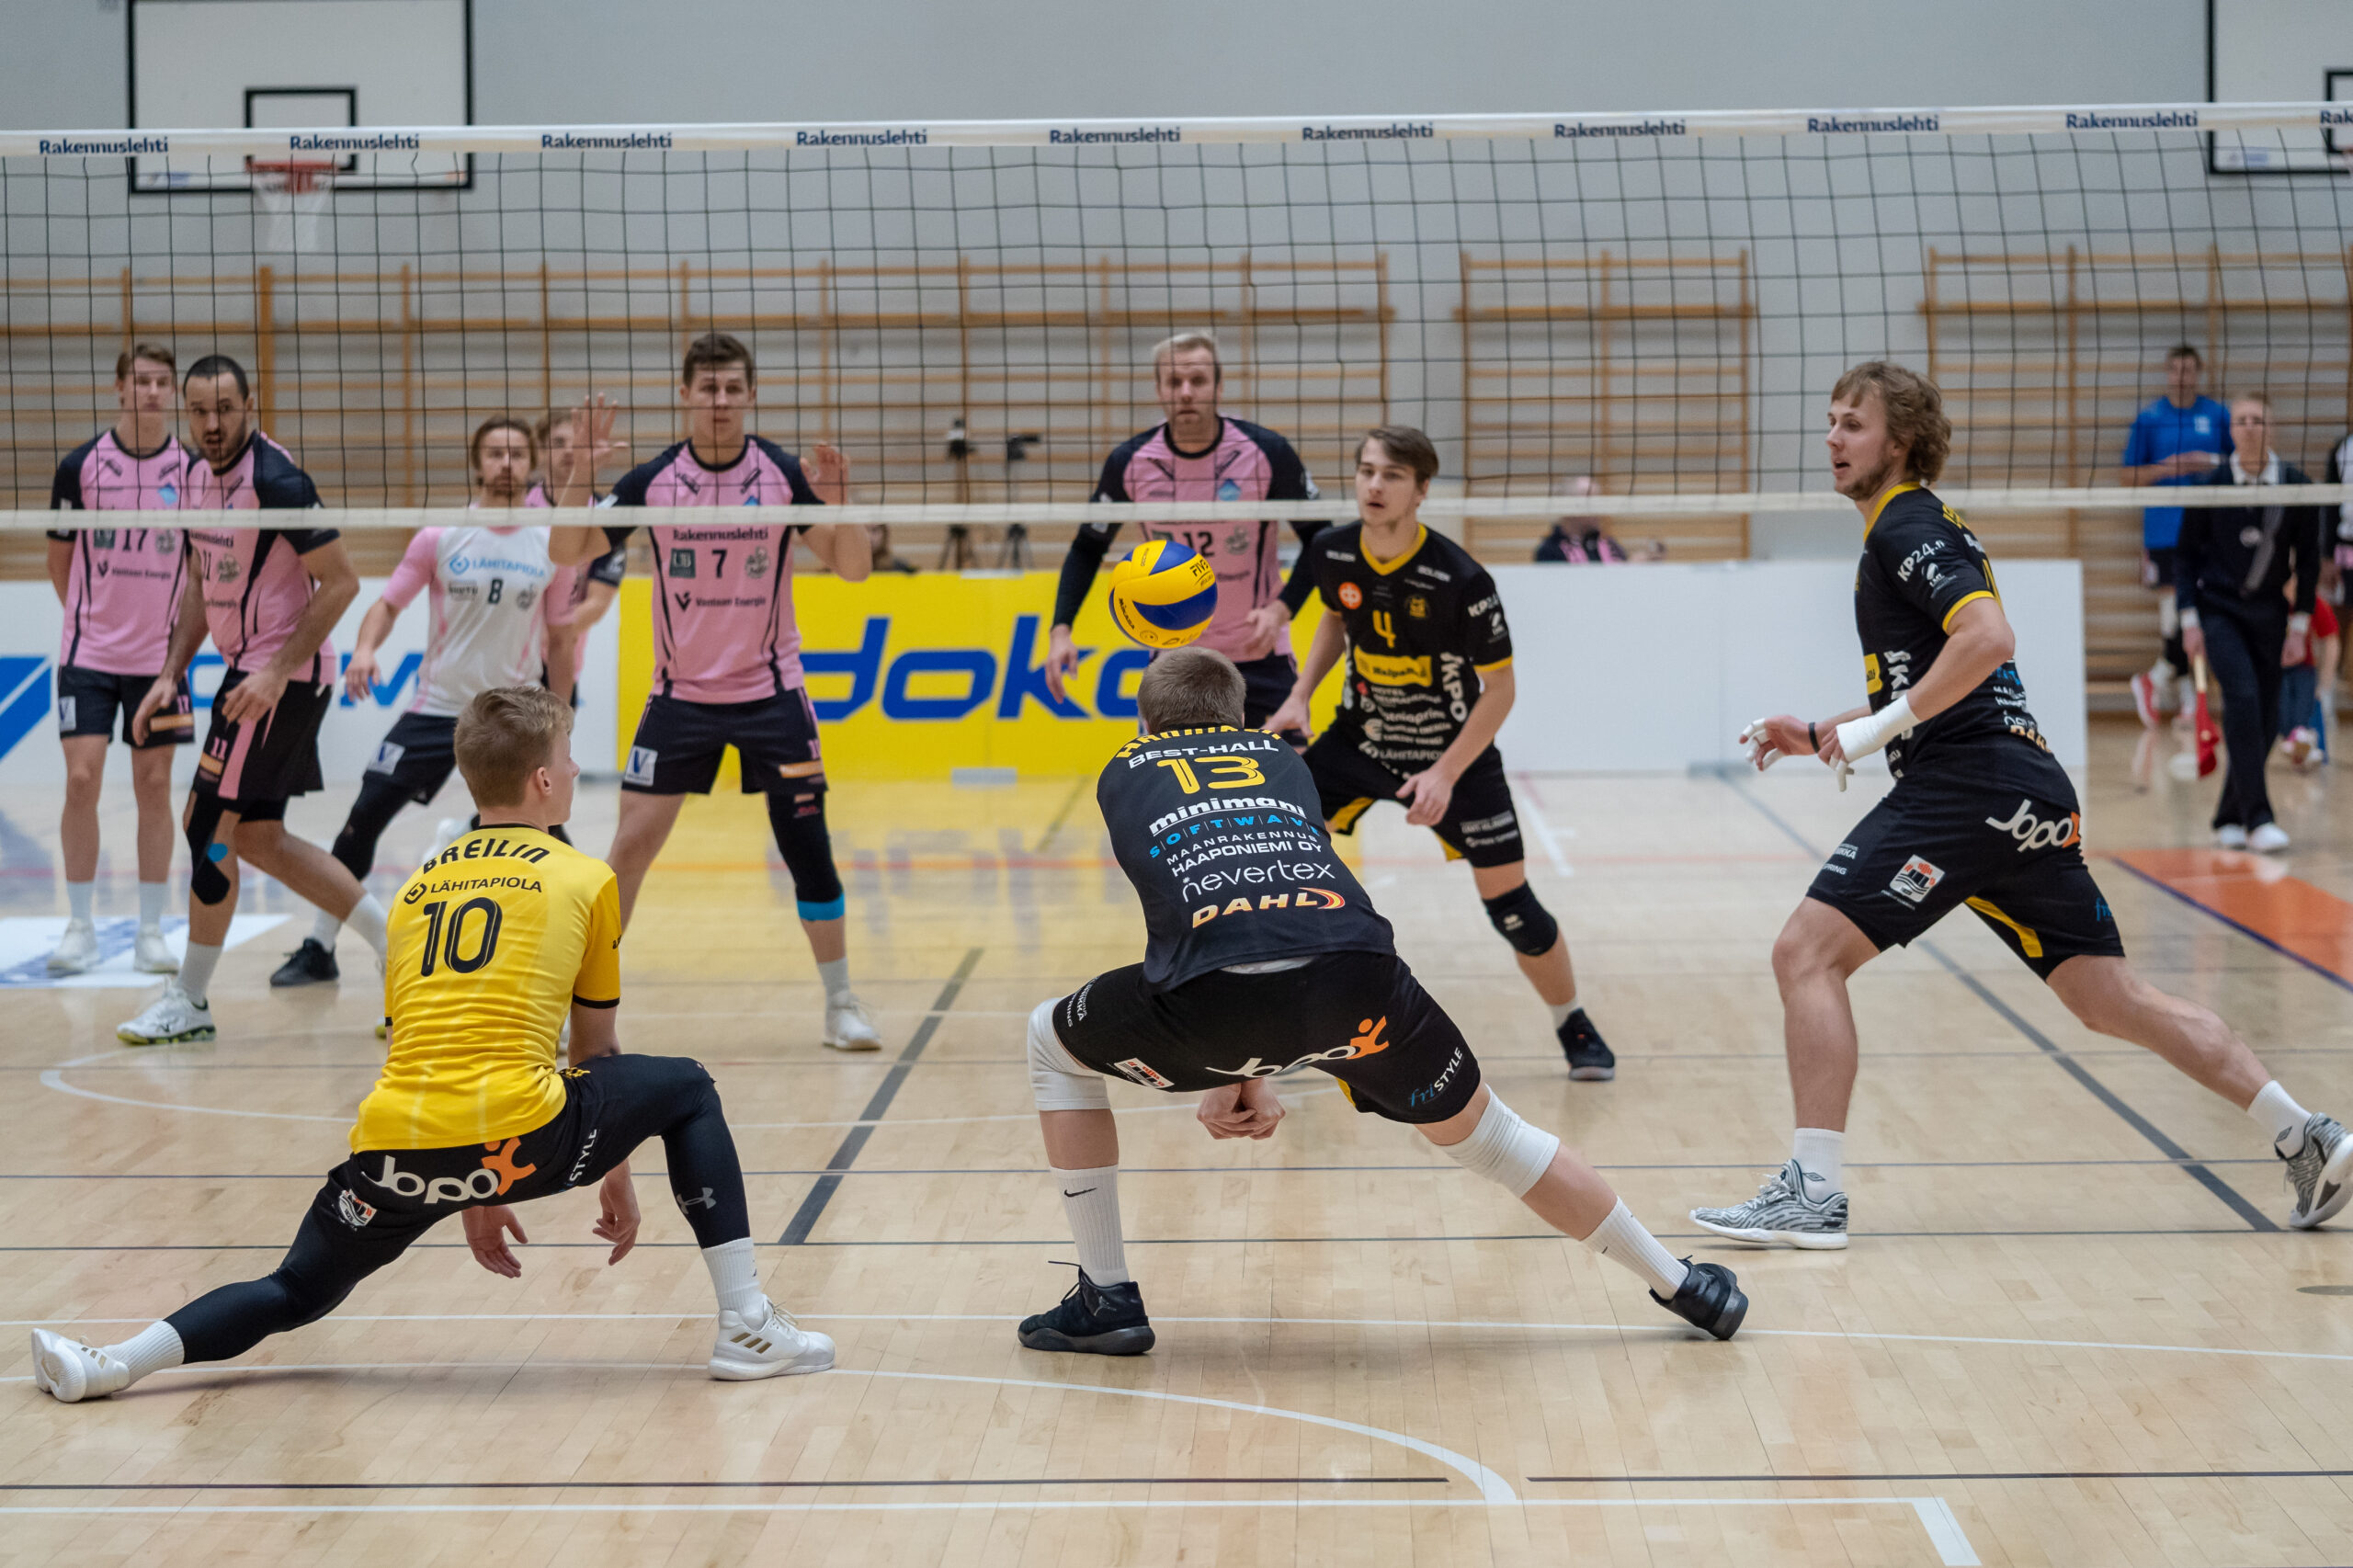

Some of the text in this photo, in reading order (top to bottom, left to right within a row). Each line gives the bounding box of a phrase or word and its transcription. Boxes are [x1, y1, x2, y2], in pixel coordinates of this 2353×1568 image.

[1553, 122, 1686, 139] Rakennuslehti
[1807, 116, 1939, 133] Rakennuslehti
[2065, 111, 2199, 129] Rakennuslehti
[39, 136, 169, 155] Rakennuslehti
[289, 134, 420, 153] Rakennuslehti
[540, 132, 673, 151] Rakennuslehti
[796, 130, 927, 146] Rakennuslehti
[1049, 127, 1182, 144] Rakennuslehti
[1302, 125, 1434, 142] Rakennuslehti
[673, 528, 769, 541] Rakennuslehti
[1182, 531, 1215, 557] 12
[711, 549, 728, 579] 7
[487, 579, 505, 605] 8
[1372, 610, 1396, 648] 4
[1128, 739, 1279, 769] BEST-HALL
[1156, 756, 1266, 795] 13
[1148, 797, 1307, 836] minimani
[422, 838, 551, 874] BREILIN
[1165, 830, 1317, 866] MAANRAKENNUS
[1171, 841, 1323, 877] HAAPONIEMI OY
[430, 876, 542, 893] LÄHITAPIOLA
[1181, 860, 1336, 903] nevertex
[1192, 892, 1318, 928] DAHL
[420, 897, 503, 977] 10
